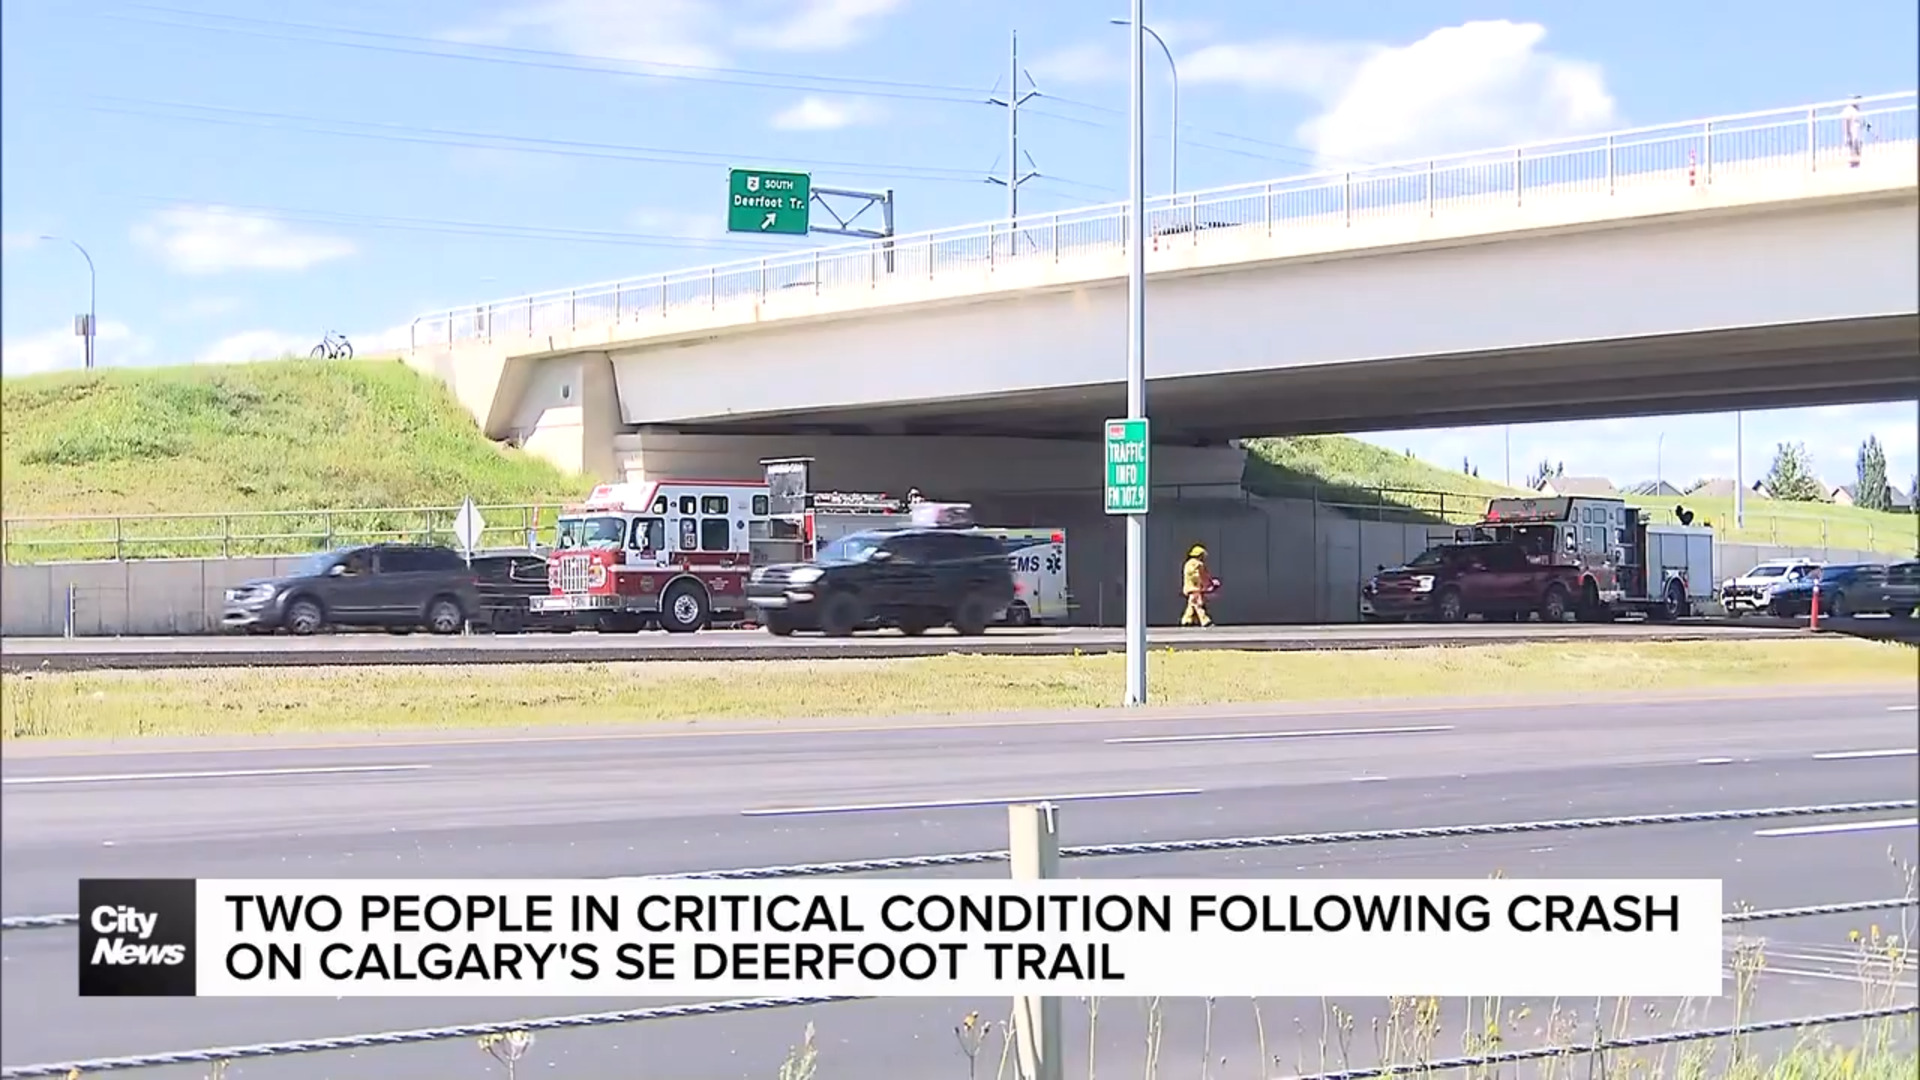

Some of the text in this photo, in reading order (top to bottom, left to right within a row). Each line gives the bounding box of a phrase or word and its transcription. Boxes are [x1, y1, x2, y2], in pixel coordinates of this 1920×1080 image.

[764, 179, 793, 190] SOUTH
[734, 195, 805, 209] Deerfoot Tr.
[1109, 441, 1145, 463] TRAFFIC
[1116, 465, 1136, 485] INFO
[1108, 486, 1145, 506] FM 107.9
[1008, 556, 1040, 572] EMS
